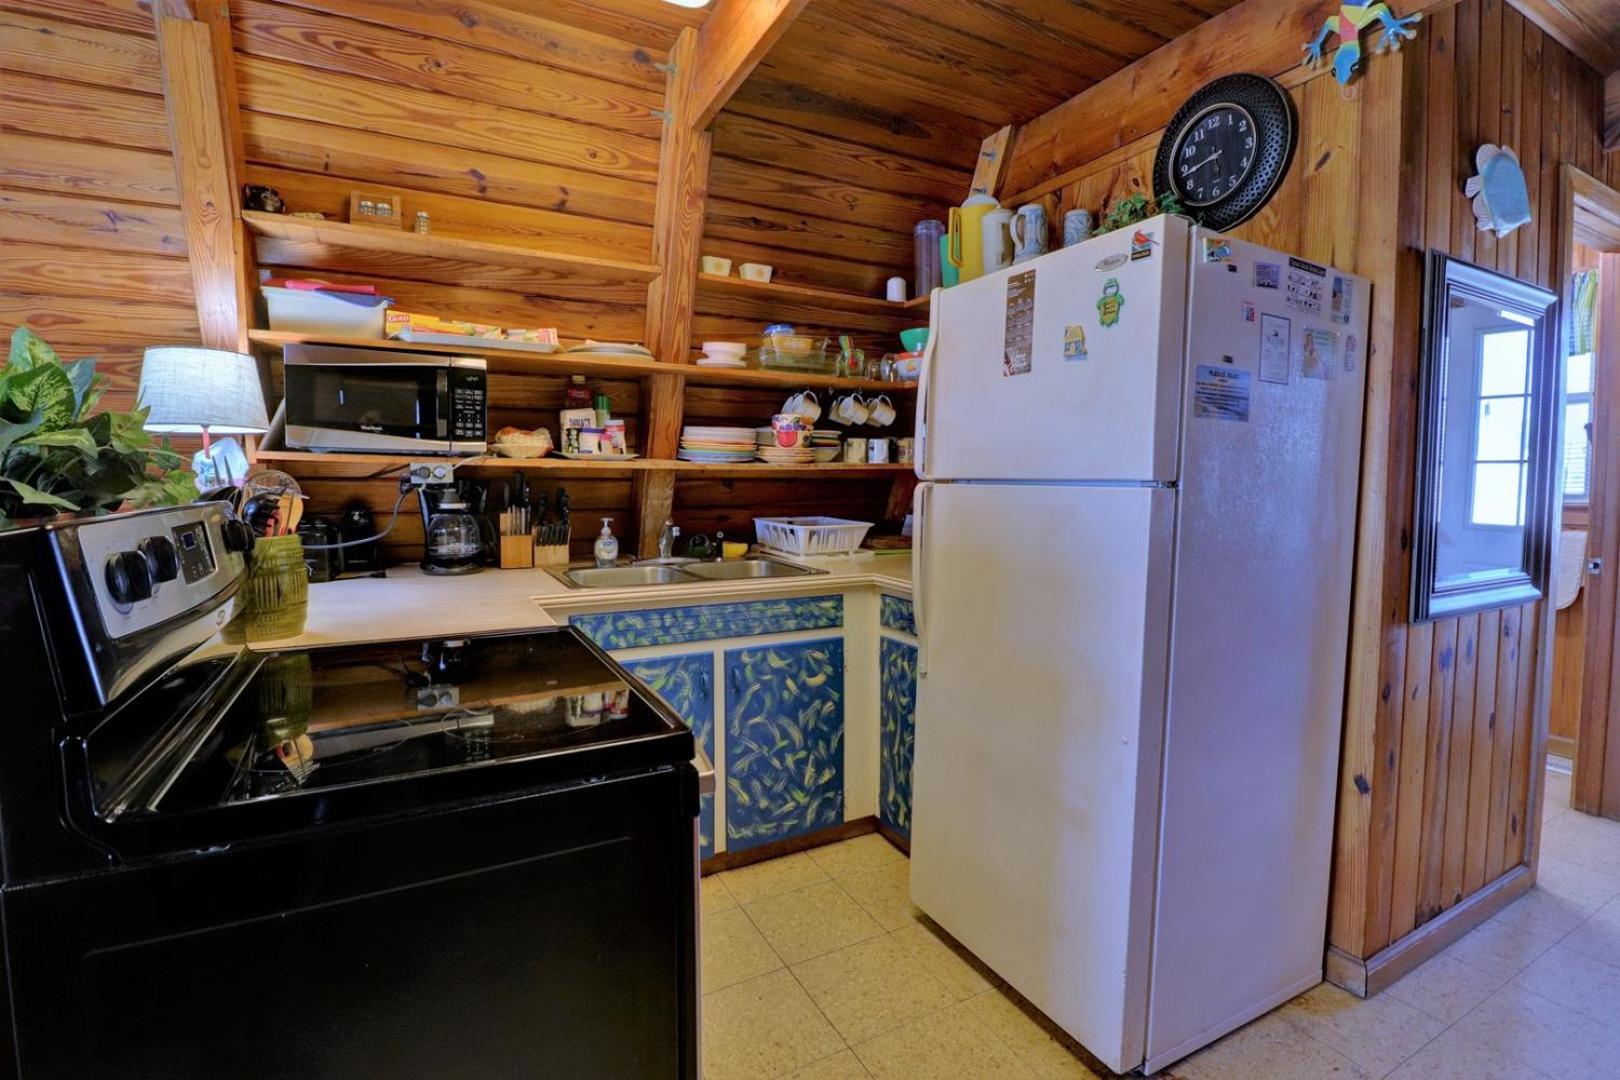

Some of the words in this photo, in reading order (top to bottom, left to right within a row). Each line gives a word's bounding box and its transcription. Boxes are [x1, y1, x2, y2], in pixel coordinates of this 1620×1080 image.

[1208, 116, 1220, 129] 12
[1227, 114, 1233, 125] 1
[1239, 120, 1247, 132] 2
[1194, 129, 1205, 142] 11
[1245, 137, 1253, 149] 3
[1184, 145, 1196, 158] 10
[1240, 156, 1248, 168] 4
[1181, 165, 1189, 177] 9
[1186, 179, 1194, 190] 8
[1228, 174, 1236, 187] 5
[1197, 187, 1204, 199] 7
[1212, 186, 1220, 197] 6
